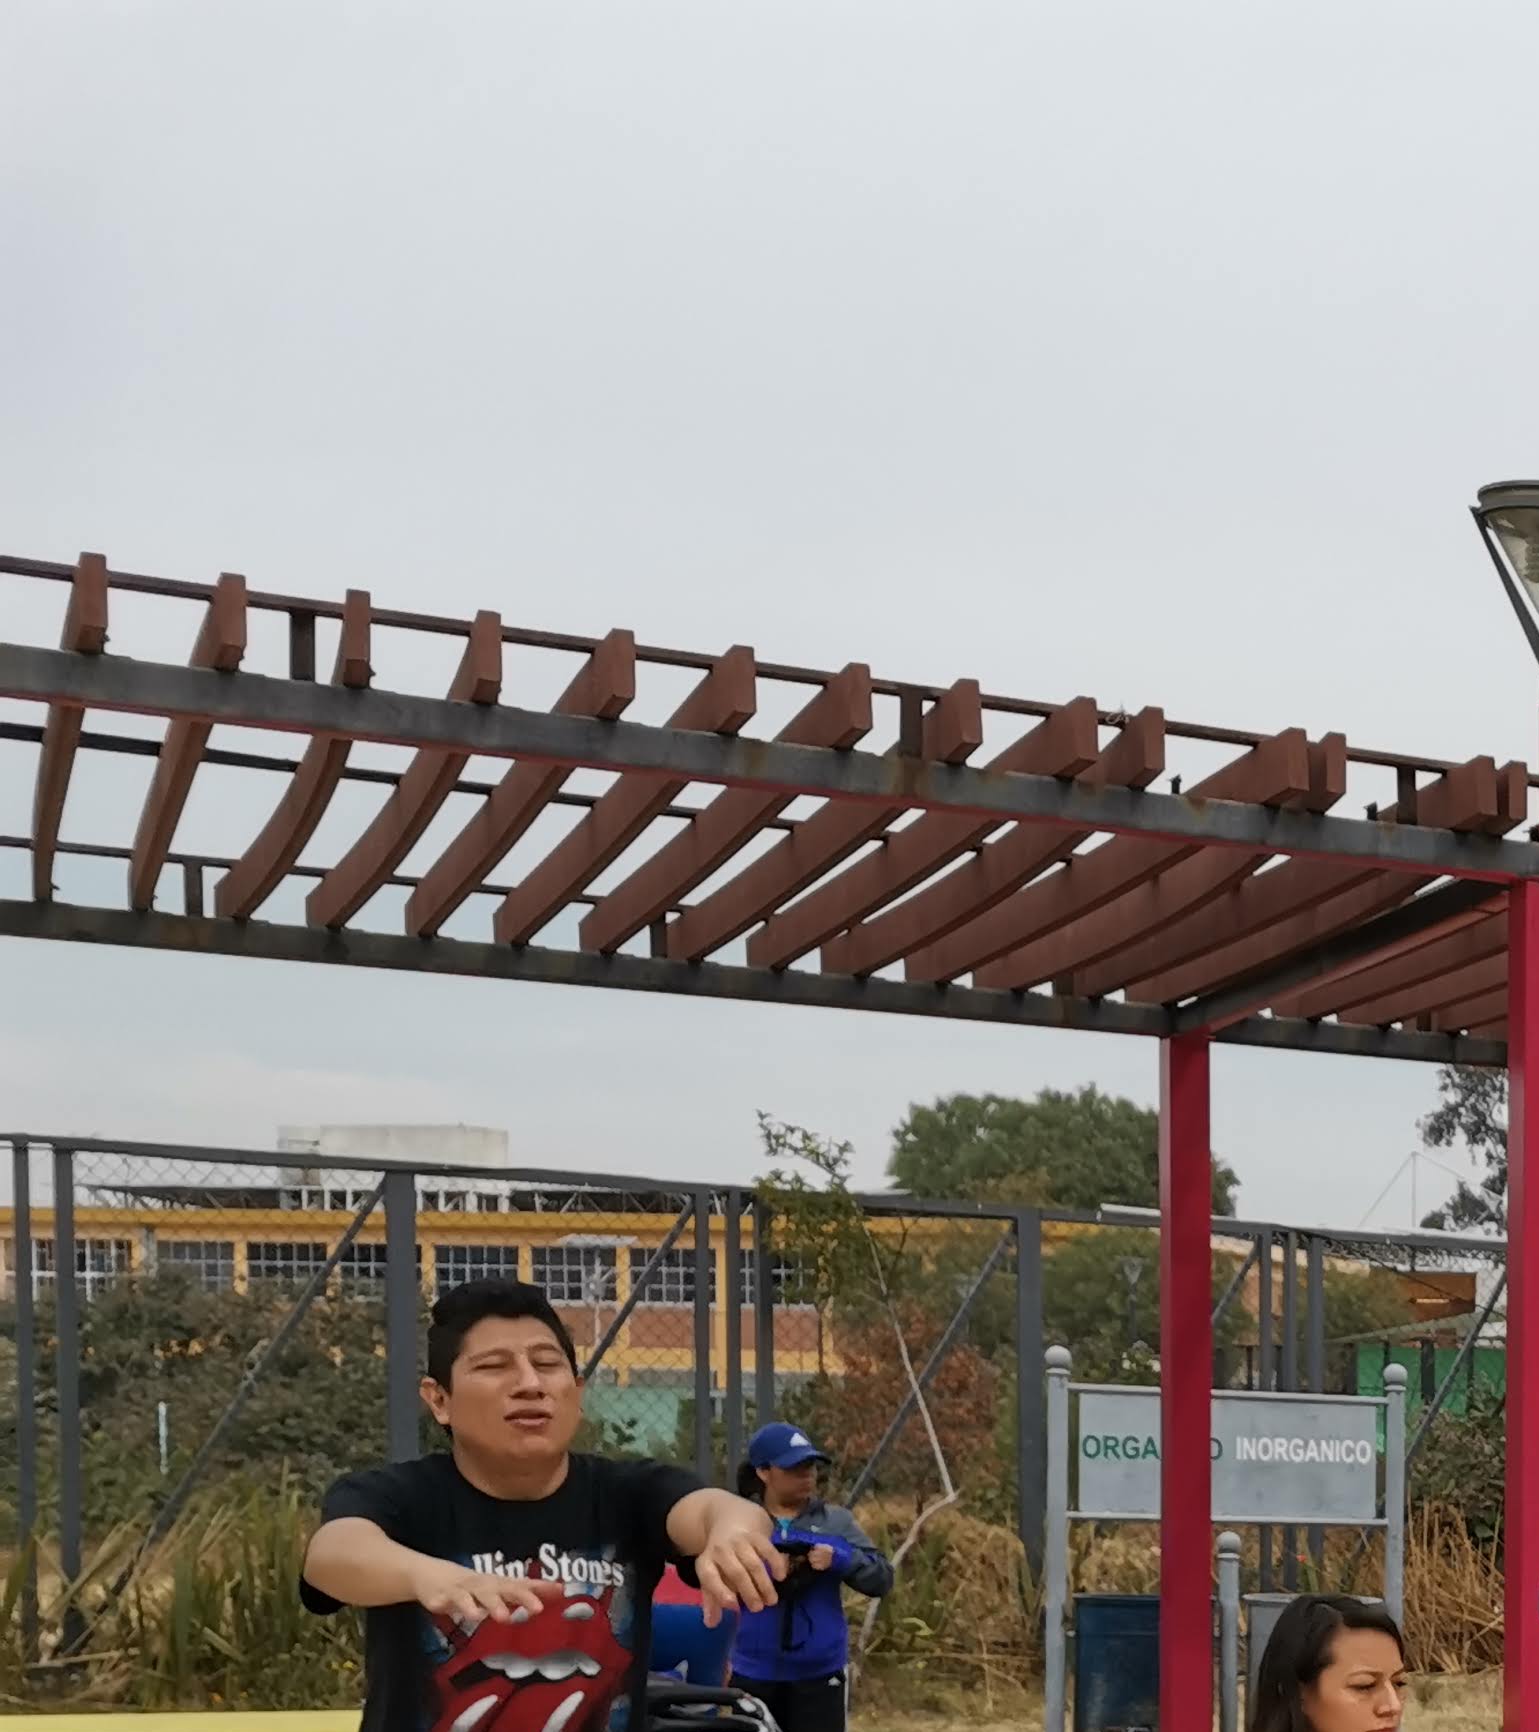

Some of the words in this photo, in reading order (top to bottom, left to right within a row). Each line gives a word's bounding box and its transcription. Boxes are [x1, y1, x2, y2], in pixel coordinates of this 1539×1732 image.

[1082, 1434, 1223, 1461] ORGAO
[1235, 1436, 1372, 1464] INORGANICO
[538, 1542, 625, 1587] Stones
